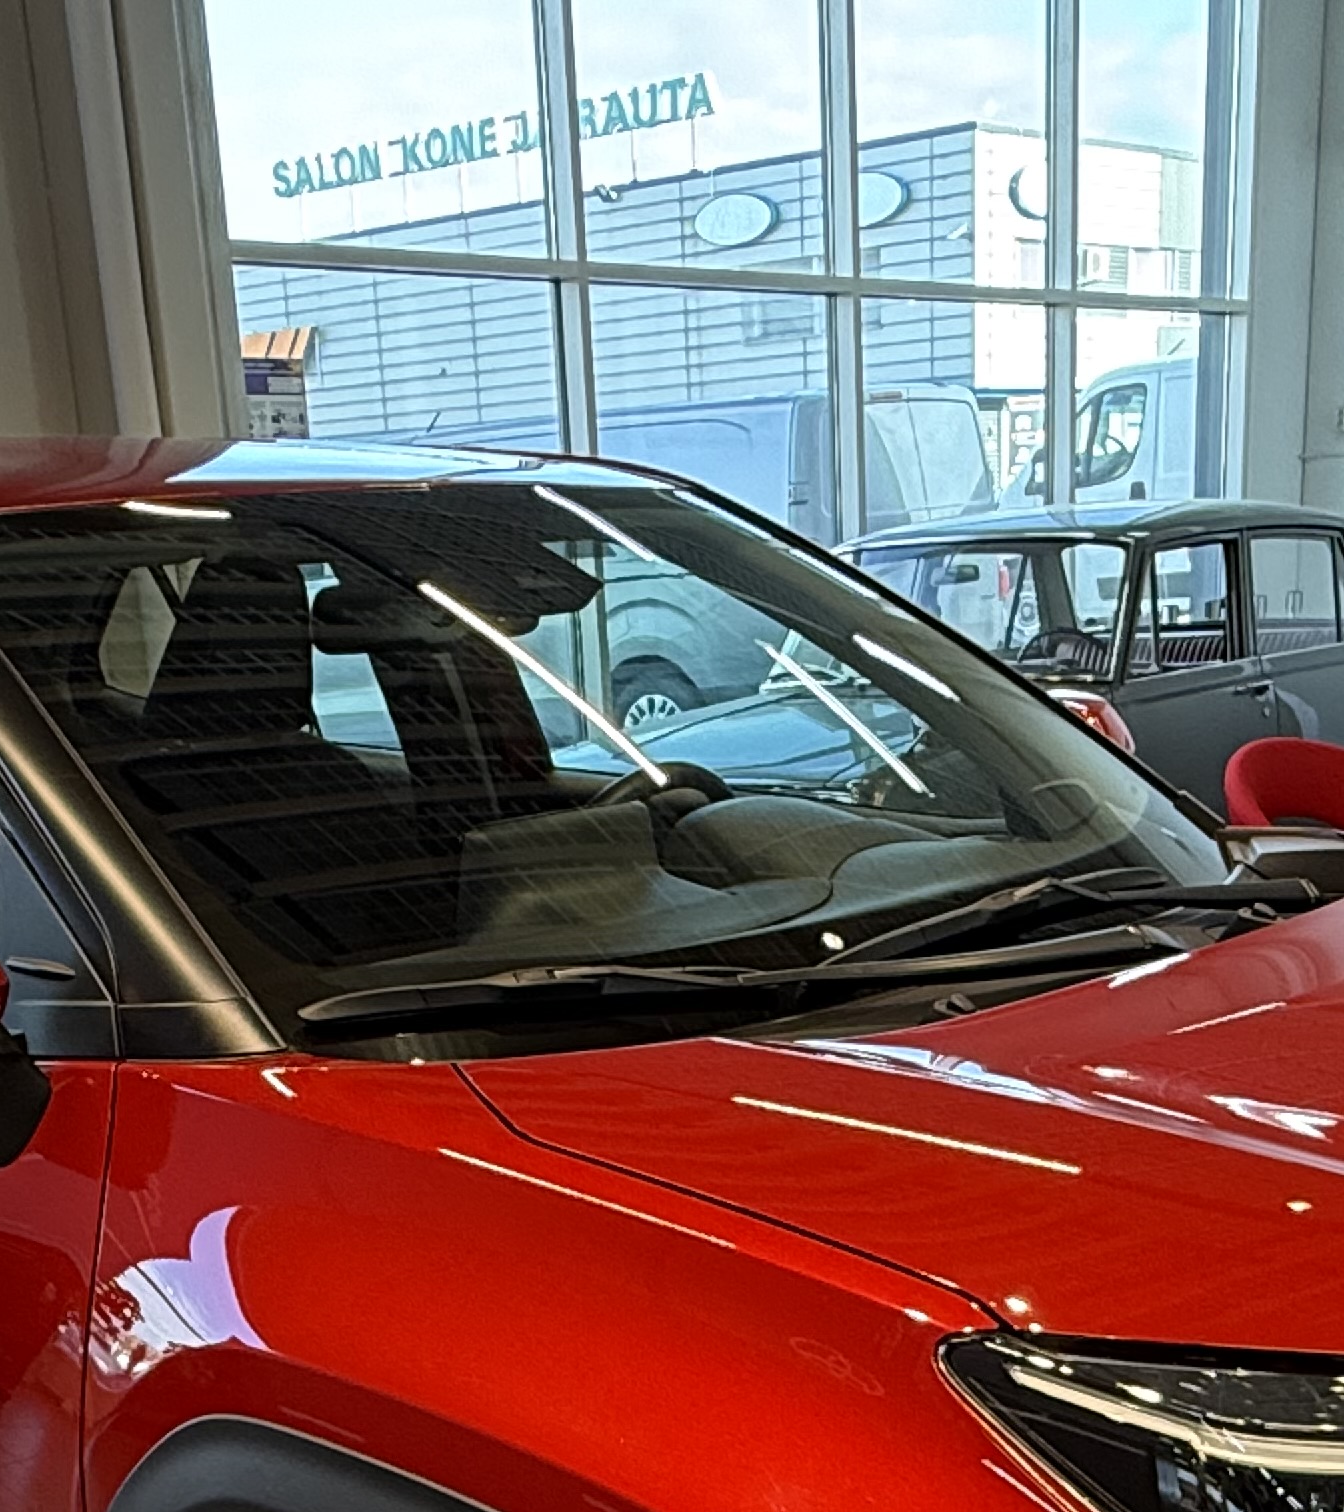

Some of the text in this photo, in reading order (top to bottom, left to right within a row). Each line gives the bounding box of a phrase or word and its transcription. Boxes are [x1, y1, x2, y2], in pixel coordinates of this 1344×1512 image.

[272, 73, 714, 198] SALON KONE J RAUTA
